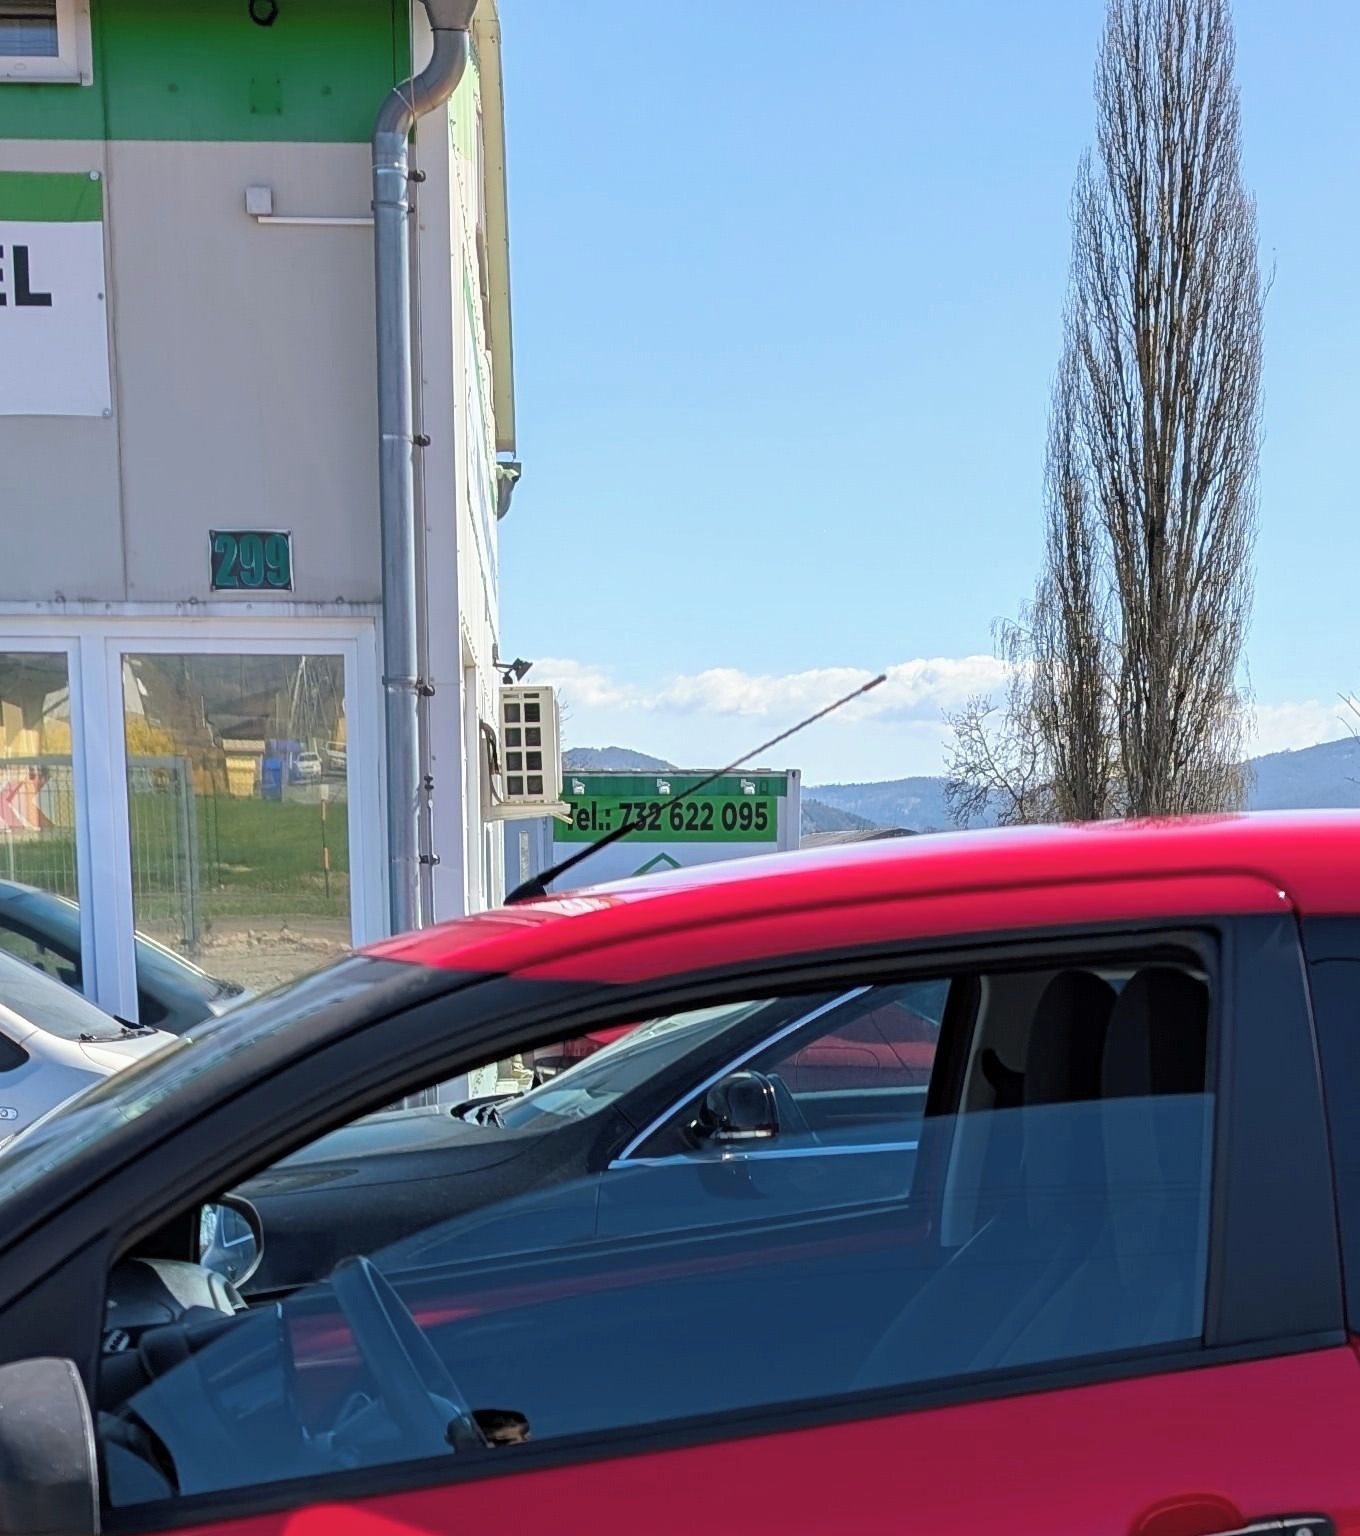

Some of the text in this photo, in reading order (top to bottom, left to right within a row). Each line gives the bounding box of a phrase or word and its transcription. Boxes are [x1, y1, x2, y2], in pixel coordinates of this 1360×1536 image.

[214, 533, 290, 587] 299
[619, 802, 662, 832] 732
[669, 801, 714, 832] 622
[721, 801, 769, 832] 095
